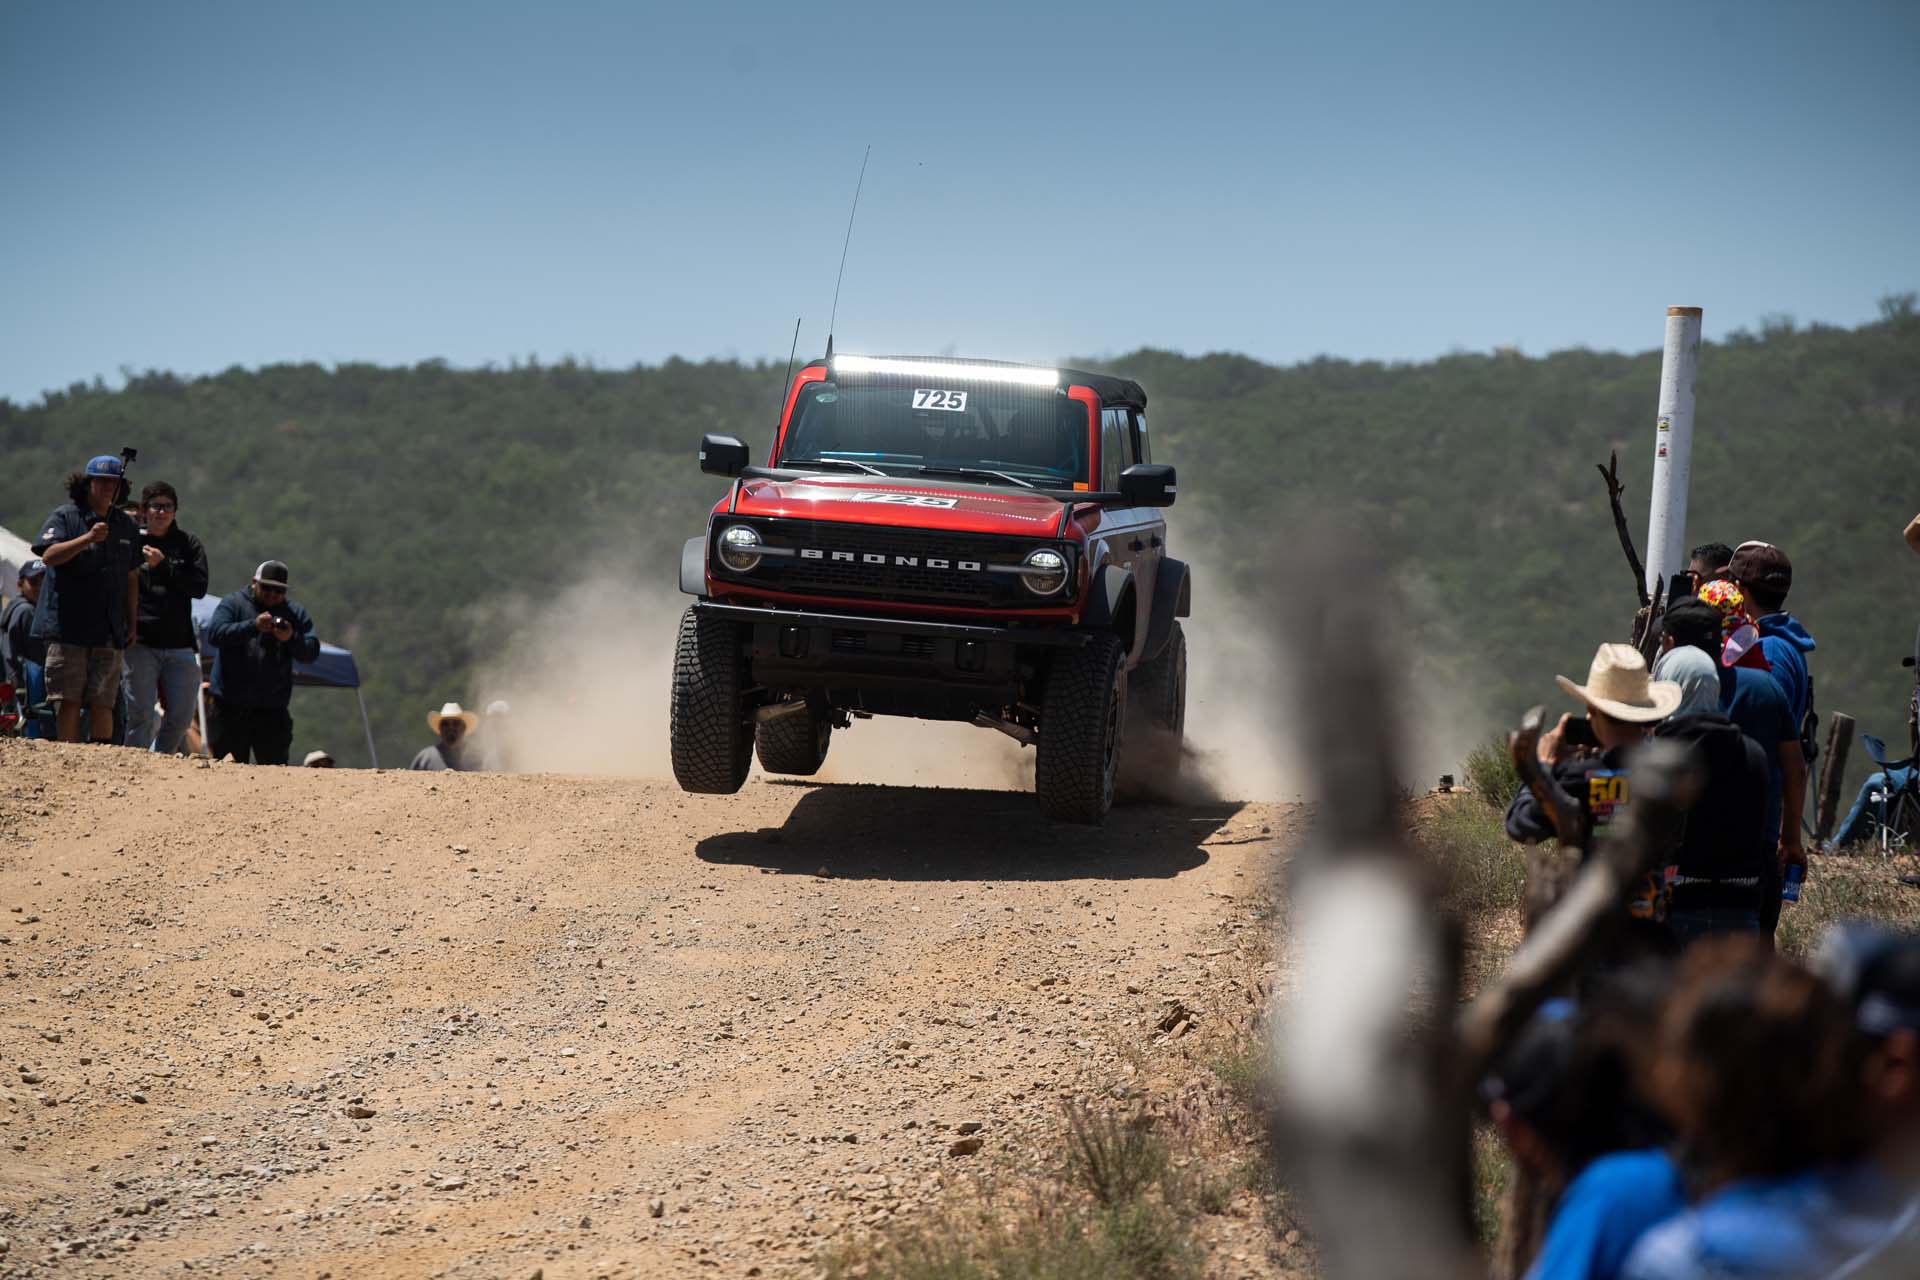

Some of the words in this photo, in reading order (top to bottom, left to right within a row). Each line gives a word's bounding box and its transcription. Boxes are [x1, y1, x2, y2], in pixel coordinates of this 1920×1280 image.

[917, 390, 962, 409] 725
[861, 494, 950, 506] 725
[801, 549, 980, 571] BRONCO
